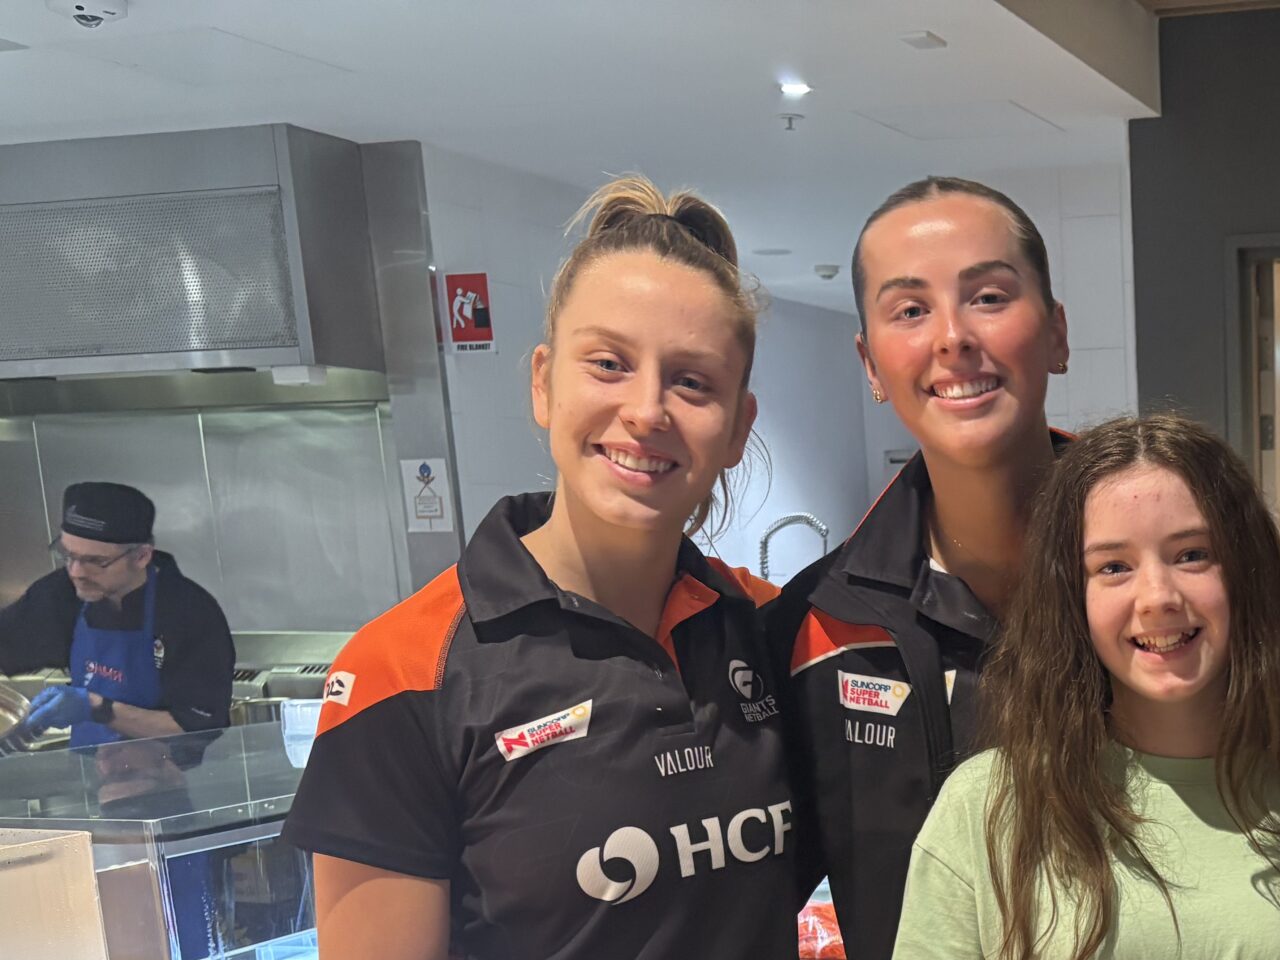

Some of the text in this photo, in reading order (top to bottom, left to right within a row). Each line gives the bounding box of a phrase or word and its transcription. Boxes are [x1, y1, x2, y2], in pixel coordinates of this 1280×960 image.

[850, 688, 880, 698] SUPER
[851, 680, 891, 692] SUNCORP
[740, 695, 776, 713] GIANTS
[849, 696, 890, 709] NETBALL
[529, 722, 562, 738] SUPER
[531, 726, 576, 747] NETBALL
[654, 746, 714, 776] VALOUR
[670, 800, 792, 878] HCF
